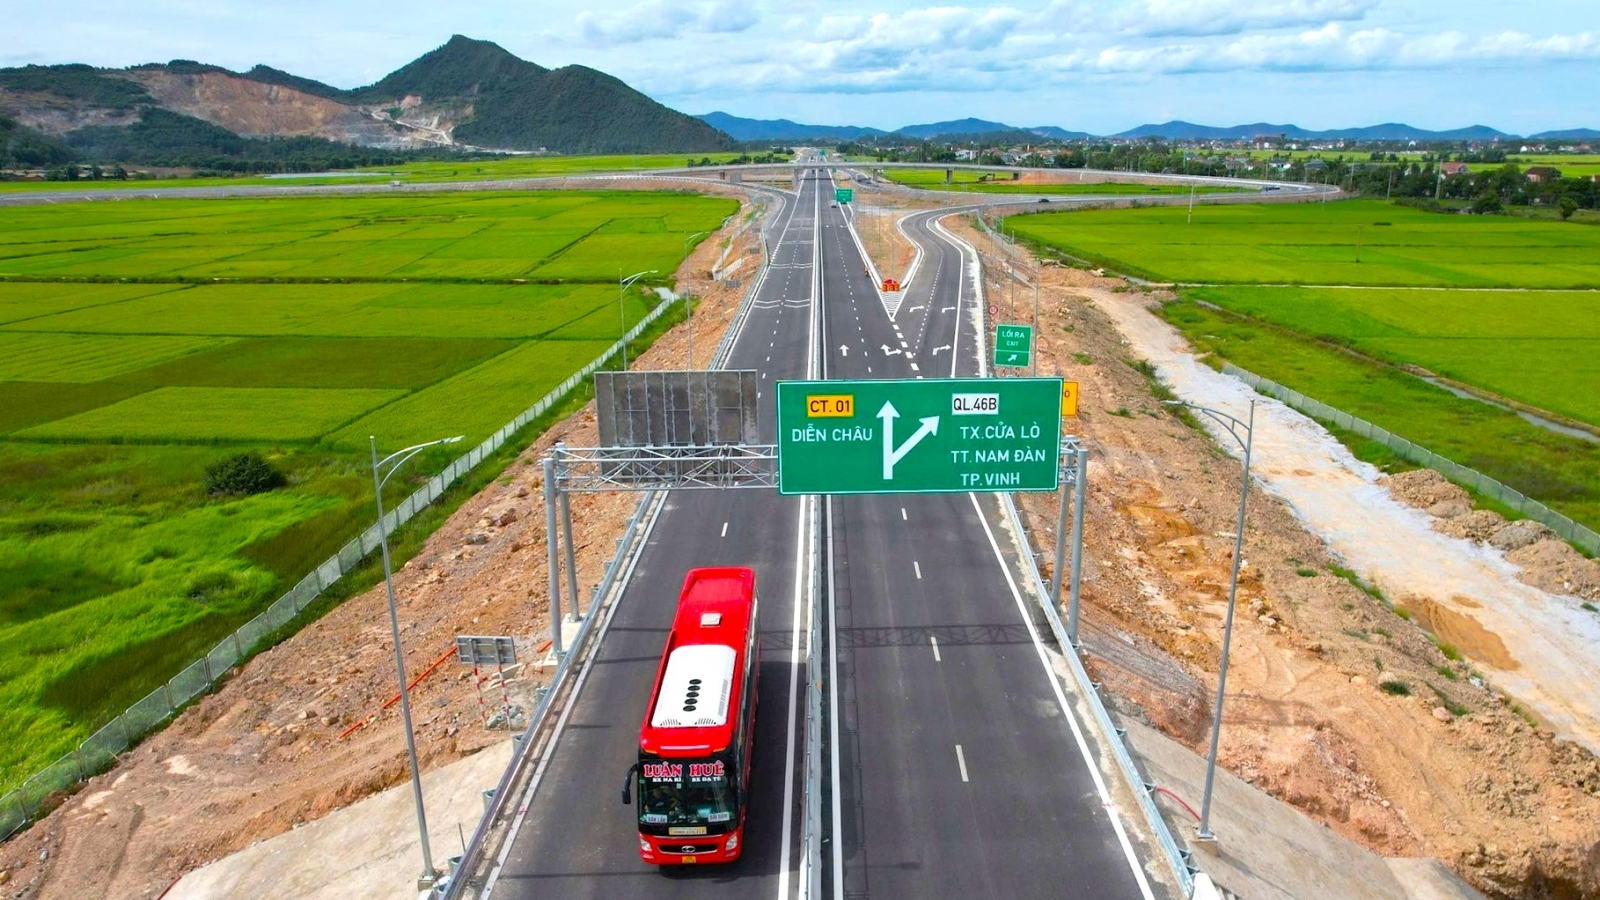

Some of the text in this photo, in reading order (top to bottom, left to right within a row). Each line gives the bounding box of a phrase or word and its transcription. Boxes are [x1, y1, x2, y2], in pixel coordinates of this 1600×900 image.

[835, 399, 851, 413] 01
[953, 397, 998, 412] QL.46B
[791, 423, 873, 442] DIỄN CHÂU
[960, 420, 1041, 440] TX.CỬA LÒ
[1013, 445, 1046, 463] ĐÀN
[960, 472, 1021, 486] TP.VINH
